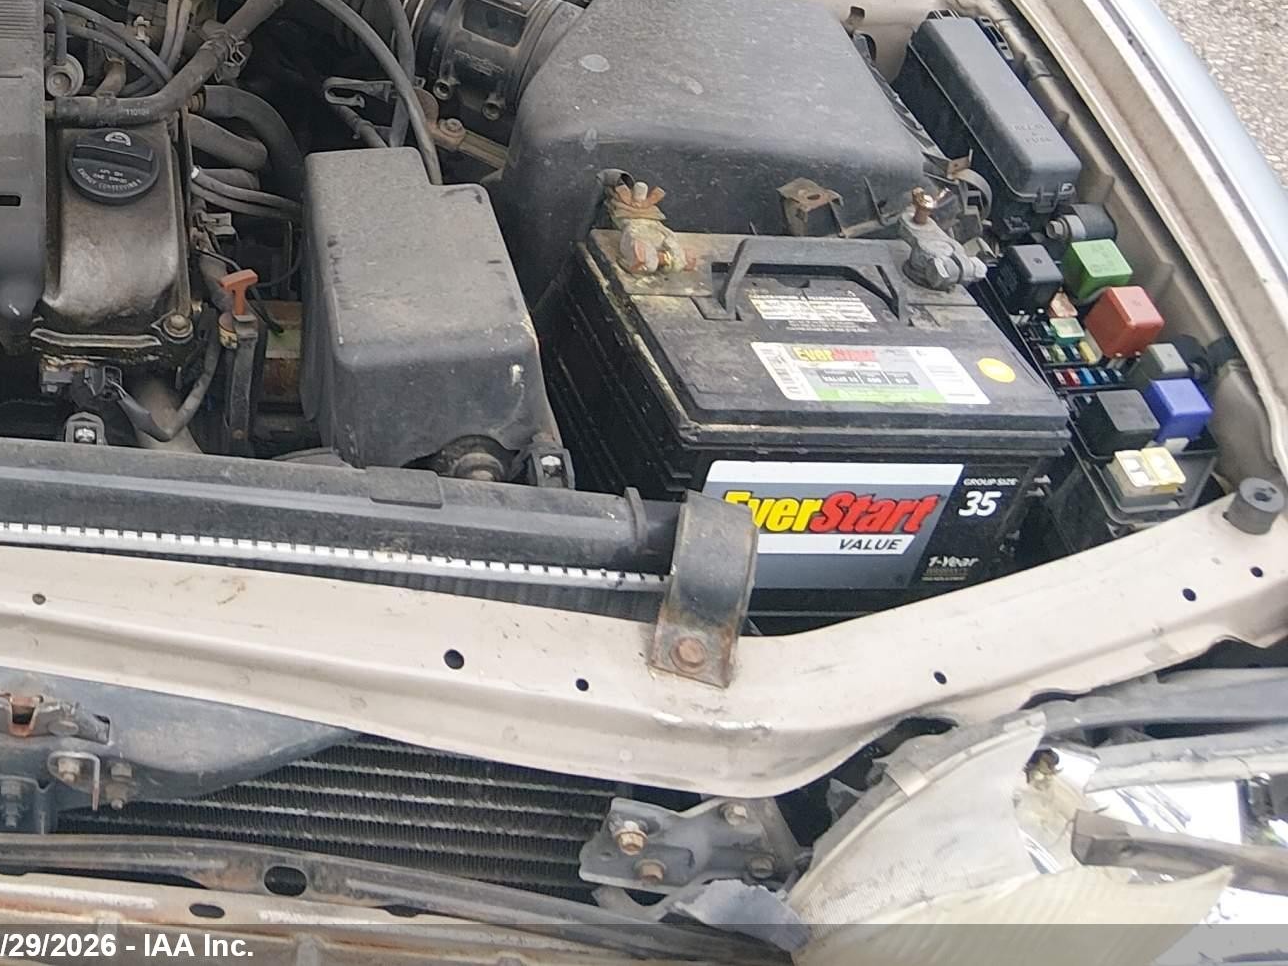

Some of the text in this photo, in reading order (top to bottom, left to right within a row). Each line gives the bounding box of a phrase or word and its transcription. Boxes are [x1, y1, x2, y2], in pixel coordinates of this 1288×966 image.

[963, 477, 996, 486] GROUP
[958, 490, 1003, 517] 35
[839, 538, 903, 551] VALUE
